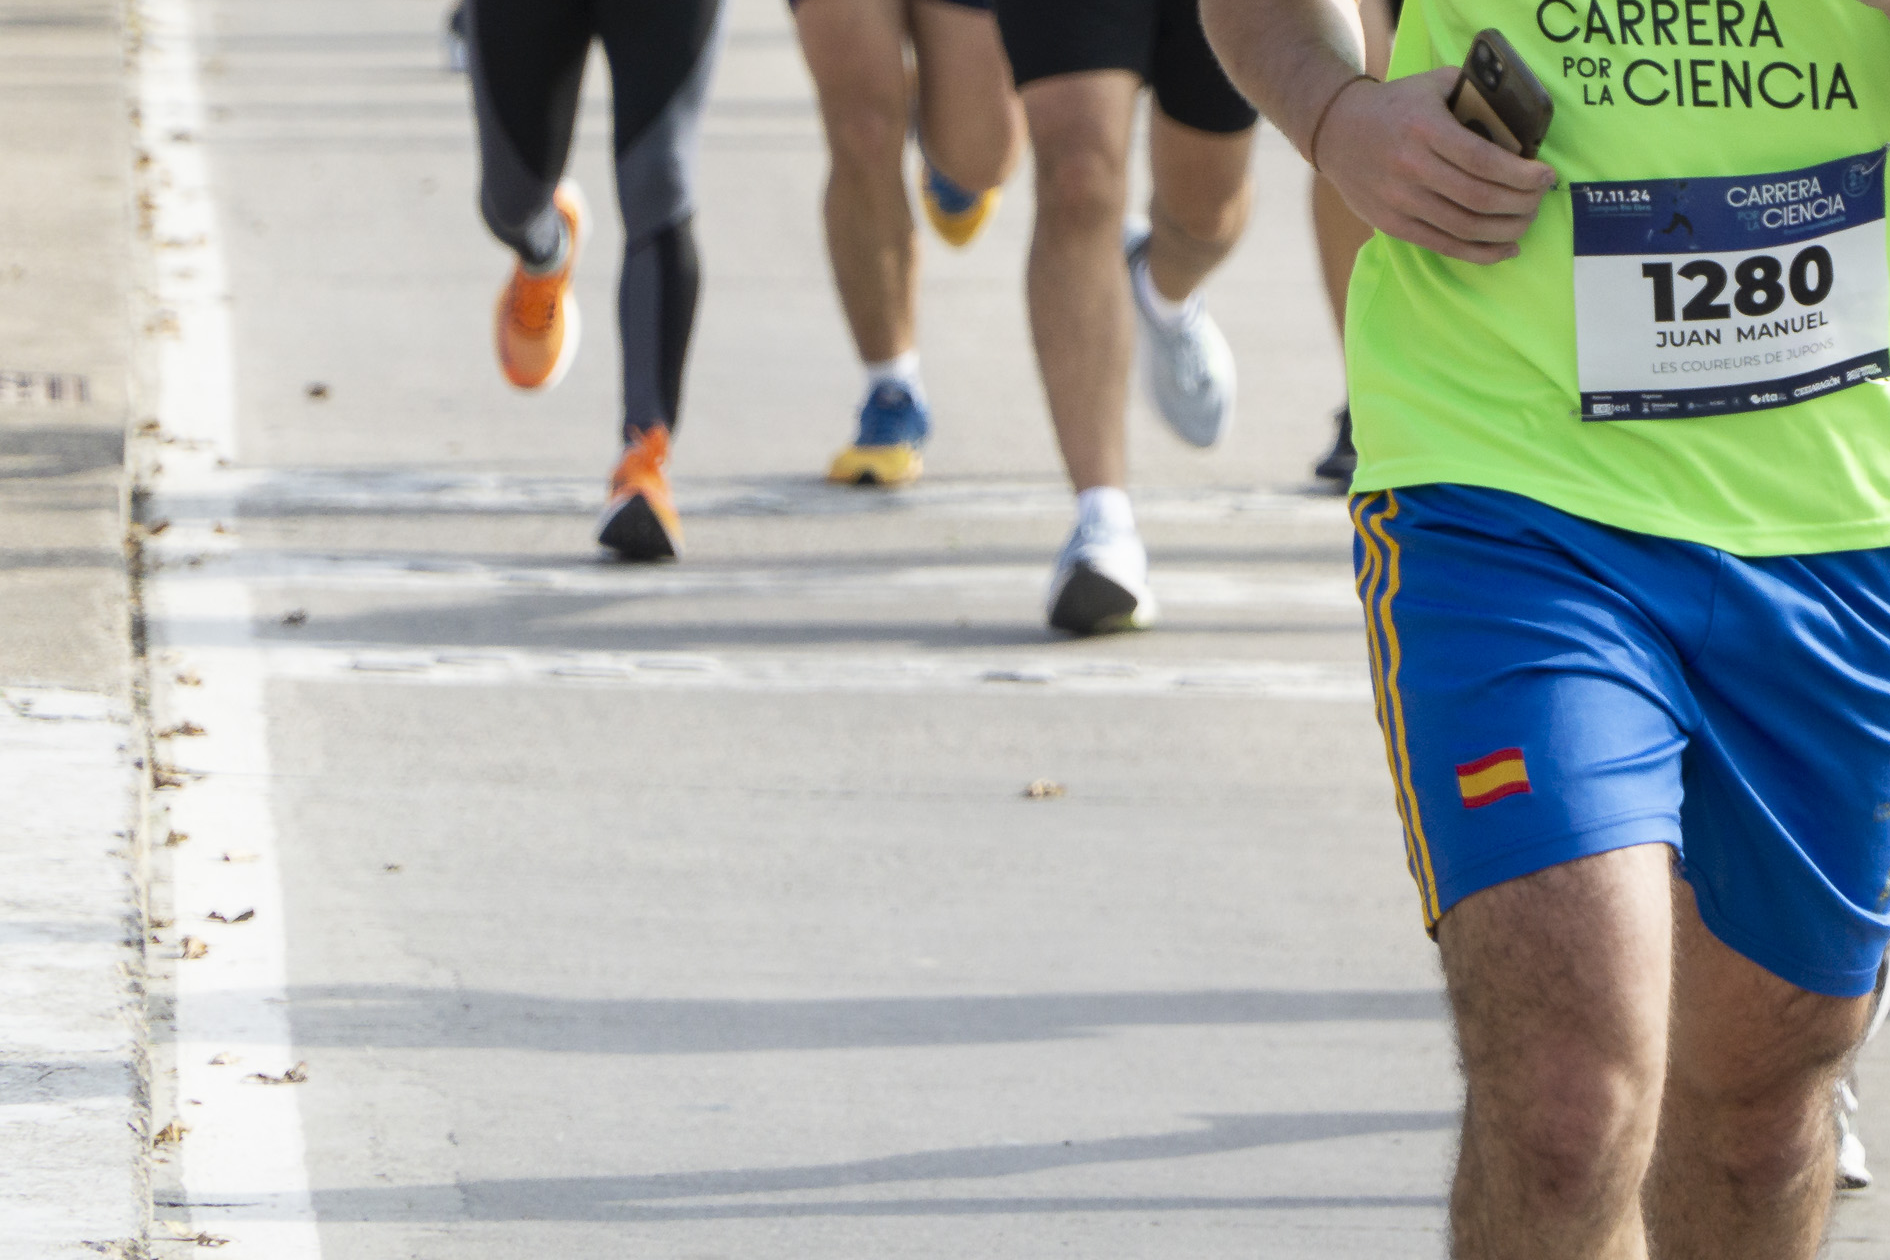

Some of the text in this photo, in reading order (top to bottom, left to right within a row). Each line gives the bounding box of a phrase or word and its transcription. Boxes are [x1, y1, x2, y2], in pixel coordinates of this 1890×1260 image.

[1563, 56, 1612, 78] POR
[1623, 58, 1859, 111] CIENCIA
[1584, 84, 1614, 106] LA
[1587, 189, 1651, 203] 17.11.24
[1726, 176, 1823, 208] CARRERA
[1762, 193, 1846, 229] CIENCIA
[1641, 244, 1835, 323] 1280
[1655, 310, 1829, 348] JUAN MANUEL
[1652, 338, 1835, 374] LES COUREURS DE JUPONS
